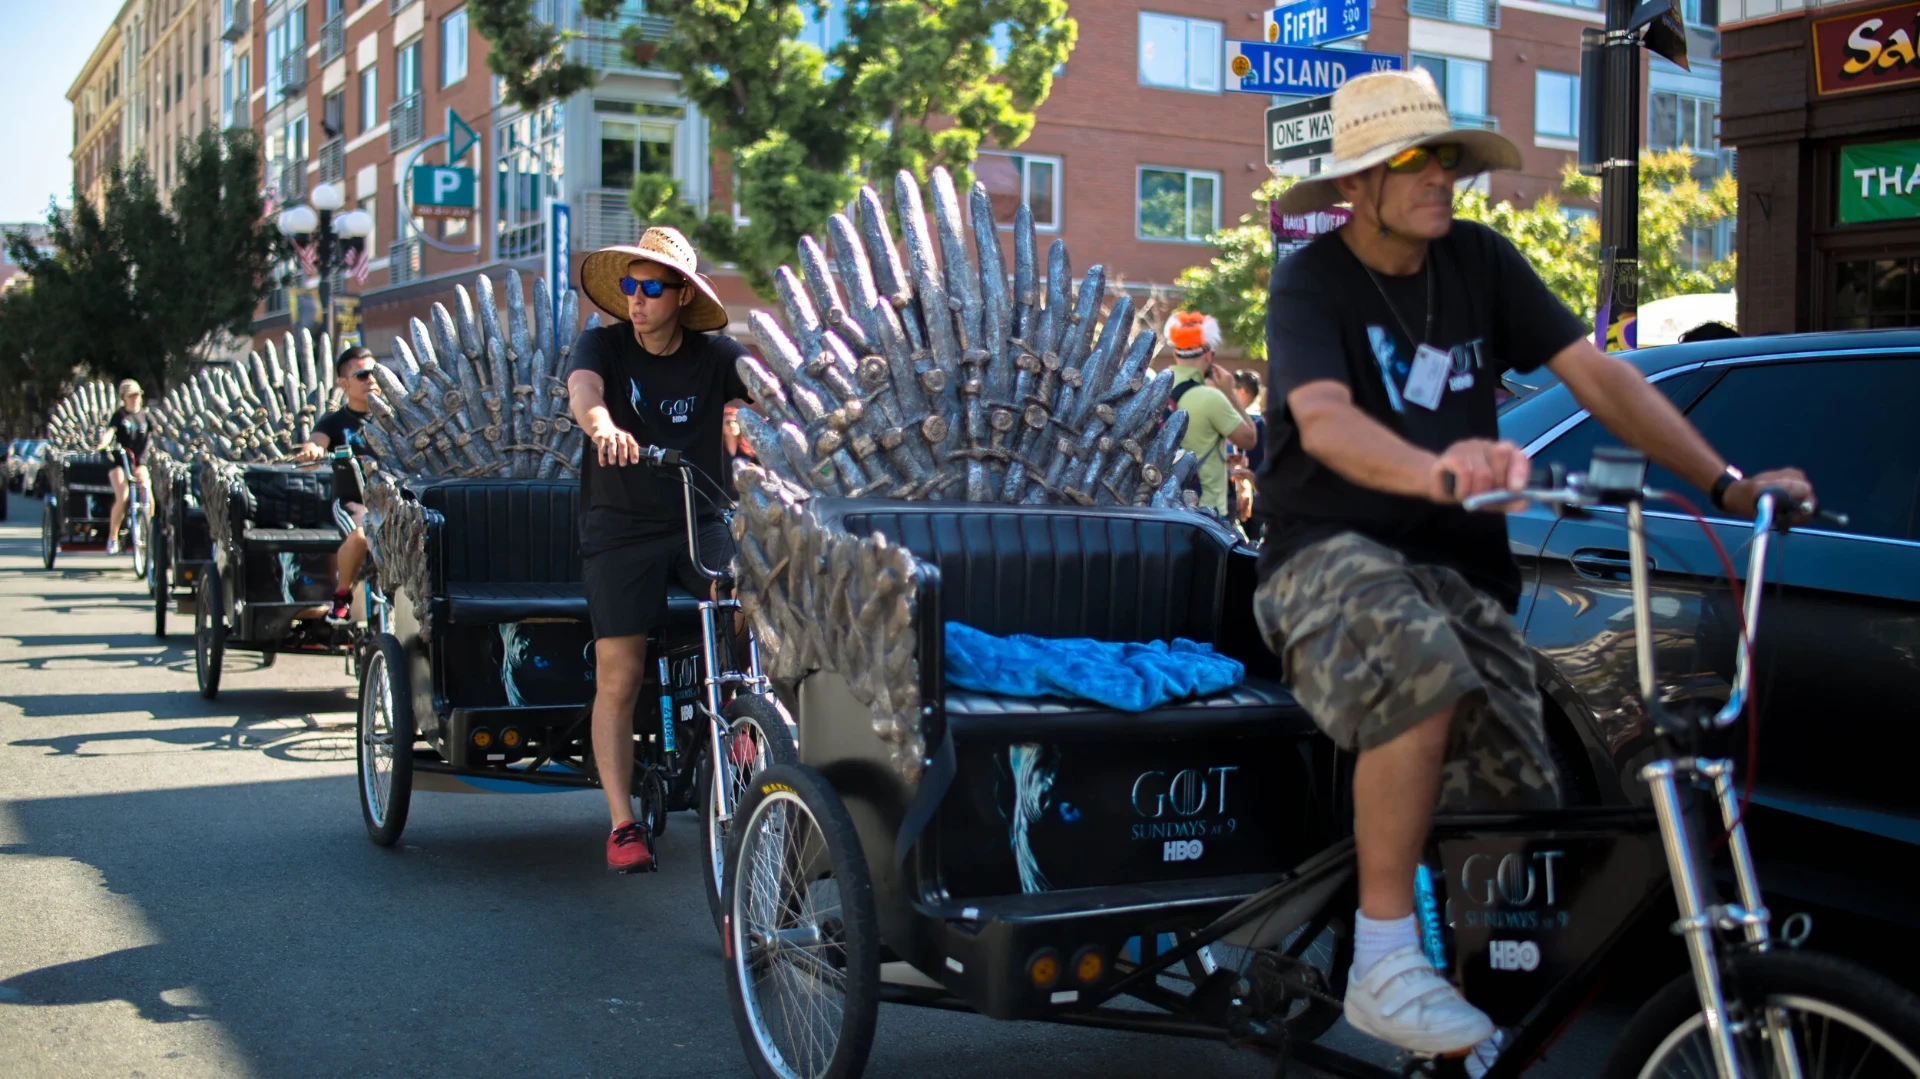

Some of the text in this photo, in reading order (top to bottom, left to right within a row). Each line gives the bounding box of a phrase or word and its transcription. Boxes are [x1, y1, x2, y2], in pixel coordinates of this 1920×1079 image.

[1283, 7, 1327, 45] FIFTH
[1342, 7, 1360, 25] 500
[1843, 11, 1920, 74] Sa
[1276, 120, 1304, 146] ONE
[433, 169, 461, 204] P
[1448, 338, 1483, 374] OT
[660, 396, 697, 415] GOT
[672, 415, 688, 424] HBO
[672, 655, 699, 688] GOT
[1132, 766, 1239, 818] GOT
[1131, 820, 1206, 840] SUNDAYS
[1227, 818, 1236, 833] 9
[1163, 839, 1204, 862] HBO
[1461, 850, 1565, 906] GOT
[1465, 911, 1538, 928] SUNDAYS
[1557, 911, 1569, 928] 9
[1489, 940, 1541, 972] HBO
